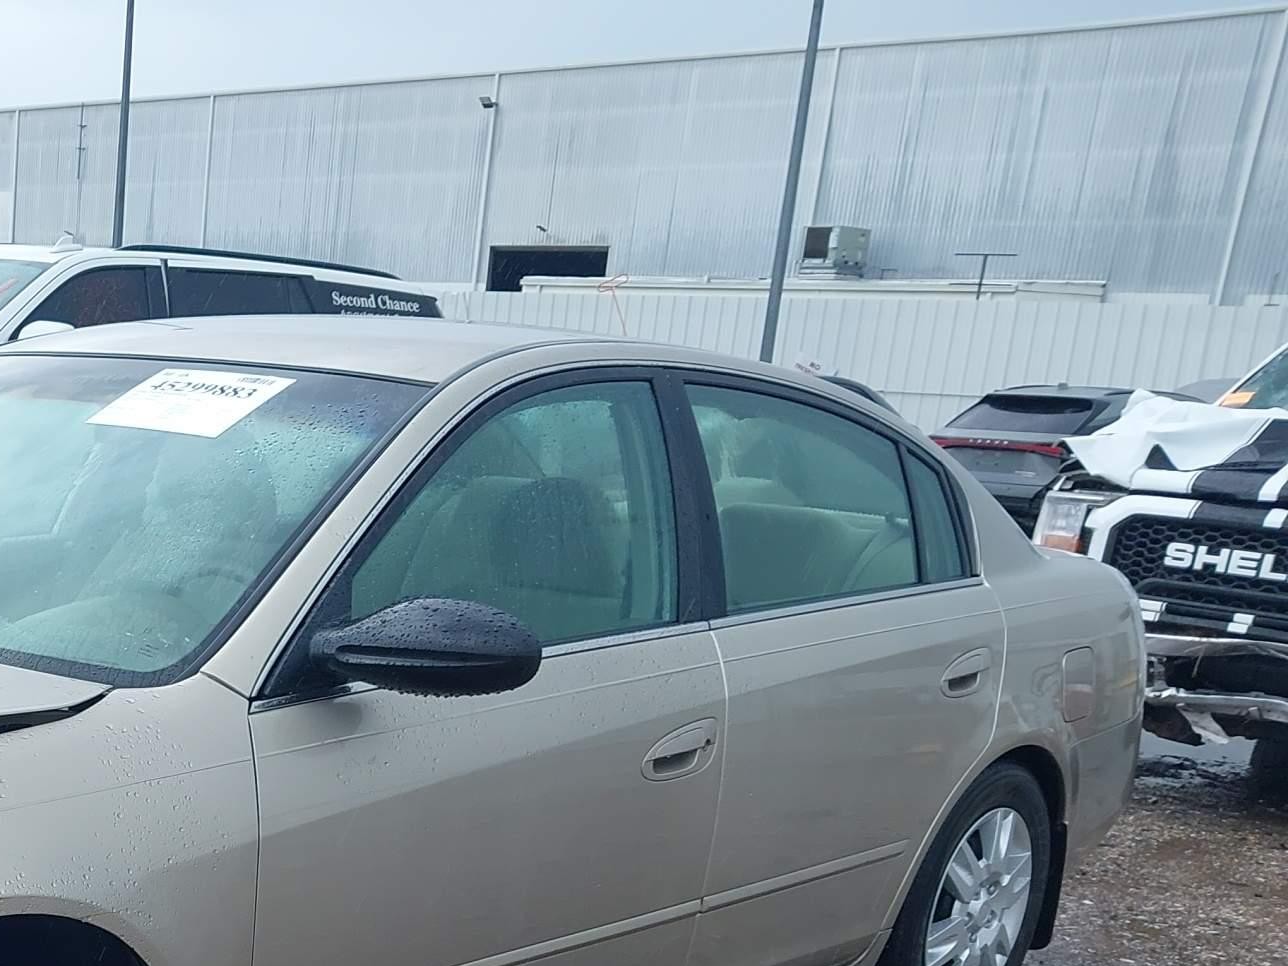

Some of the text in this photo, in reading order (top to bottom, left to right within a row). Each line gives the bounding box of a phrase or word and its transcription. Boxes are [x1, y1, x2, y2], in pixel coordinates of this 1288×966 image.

[331, 290, 421, 312] Second Chance
[151, 380, 258, 399] 45299883
